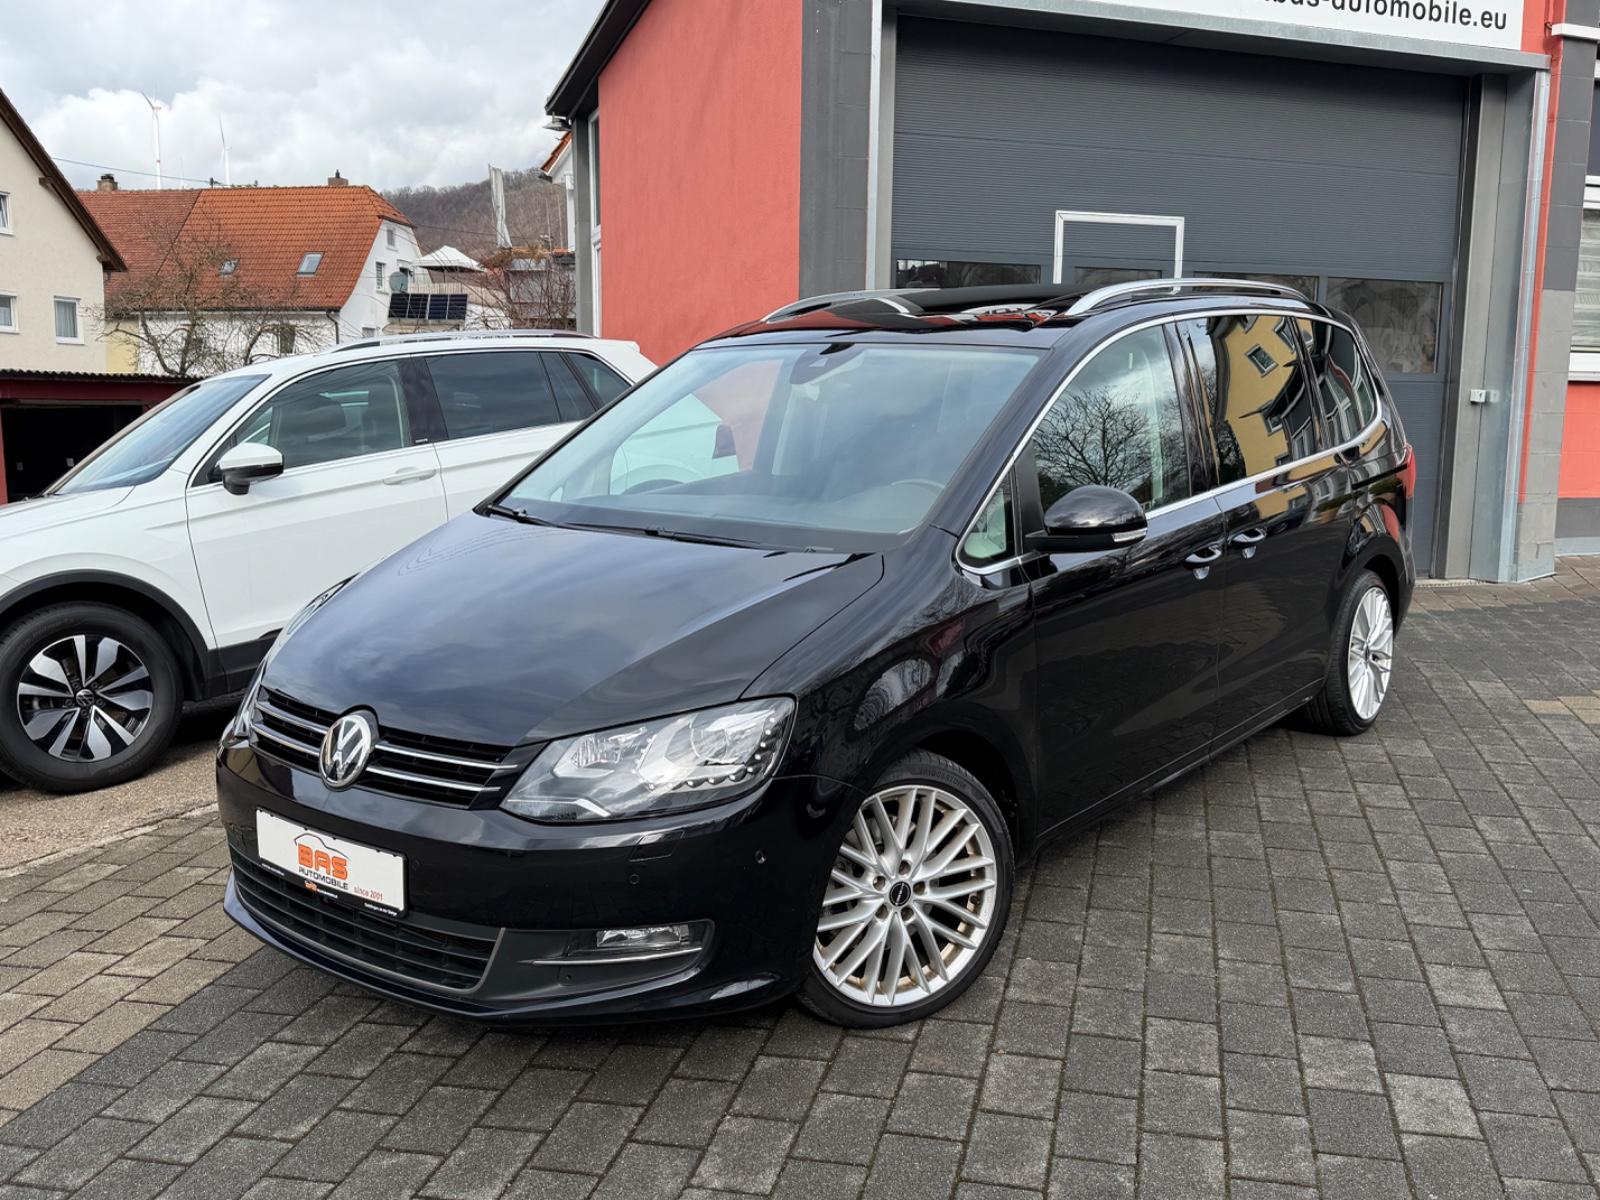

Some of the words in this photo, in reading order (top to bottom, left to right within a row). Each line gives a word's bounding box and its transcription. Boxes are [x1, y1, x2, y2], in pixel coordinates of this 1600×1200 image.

[1264, 0, 1506, 30] automobile.eu
[298, 843, 348, 881] BAS
[299, 866, 349, 891] AUTOMOBILE
[353, 885, 369, 897] since
[370, 890, 383, 901] 2001
